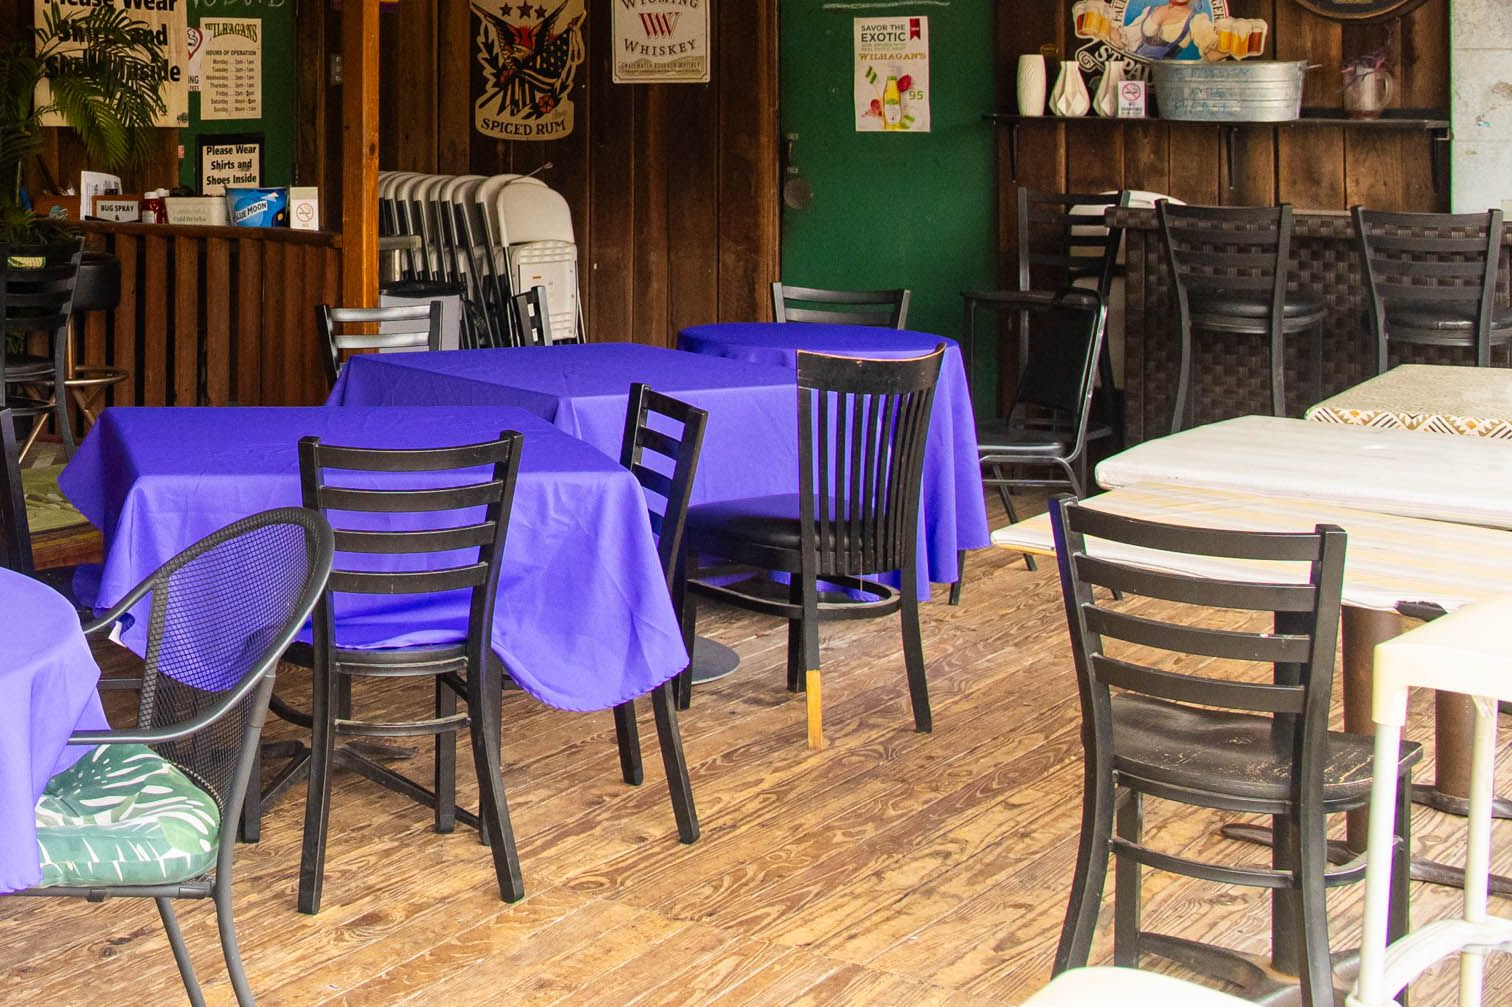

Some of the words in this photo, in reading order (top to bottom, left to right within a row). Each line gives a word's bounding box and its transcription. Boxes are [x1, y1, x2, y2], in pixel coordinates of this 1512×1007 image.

[861, 24, 888, 32] SAVOR
[861, 32, 906, 42] EXOTIC
[624, 38, 697, 56] WHISKEY
[858, 52, 926, 61] WILHAGAN'S
[908, 90, 924, 101] 95
[480, 118, 533, 136] SPICED
[535, 119, 566, 135] RUM
[206, 144, 234, 156] Please
[235, 144, 257, 155] Wear
[210, 159, 235, 171] Shirts
[237, 158, 253, 169] and
[206, 174, 230, 186] Shoes
[232, 173, 257, 185] Inside
[100, 204, 113, 213] BUG
[114, 204, 135, 213] SPRAY
[247, 201, 268, 216] MOON
